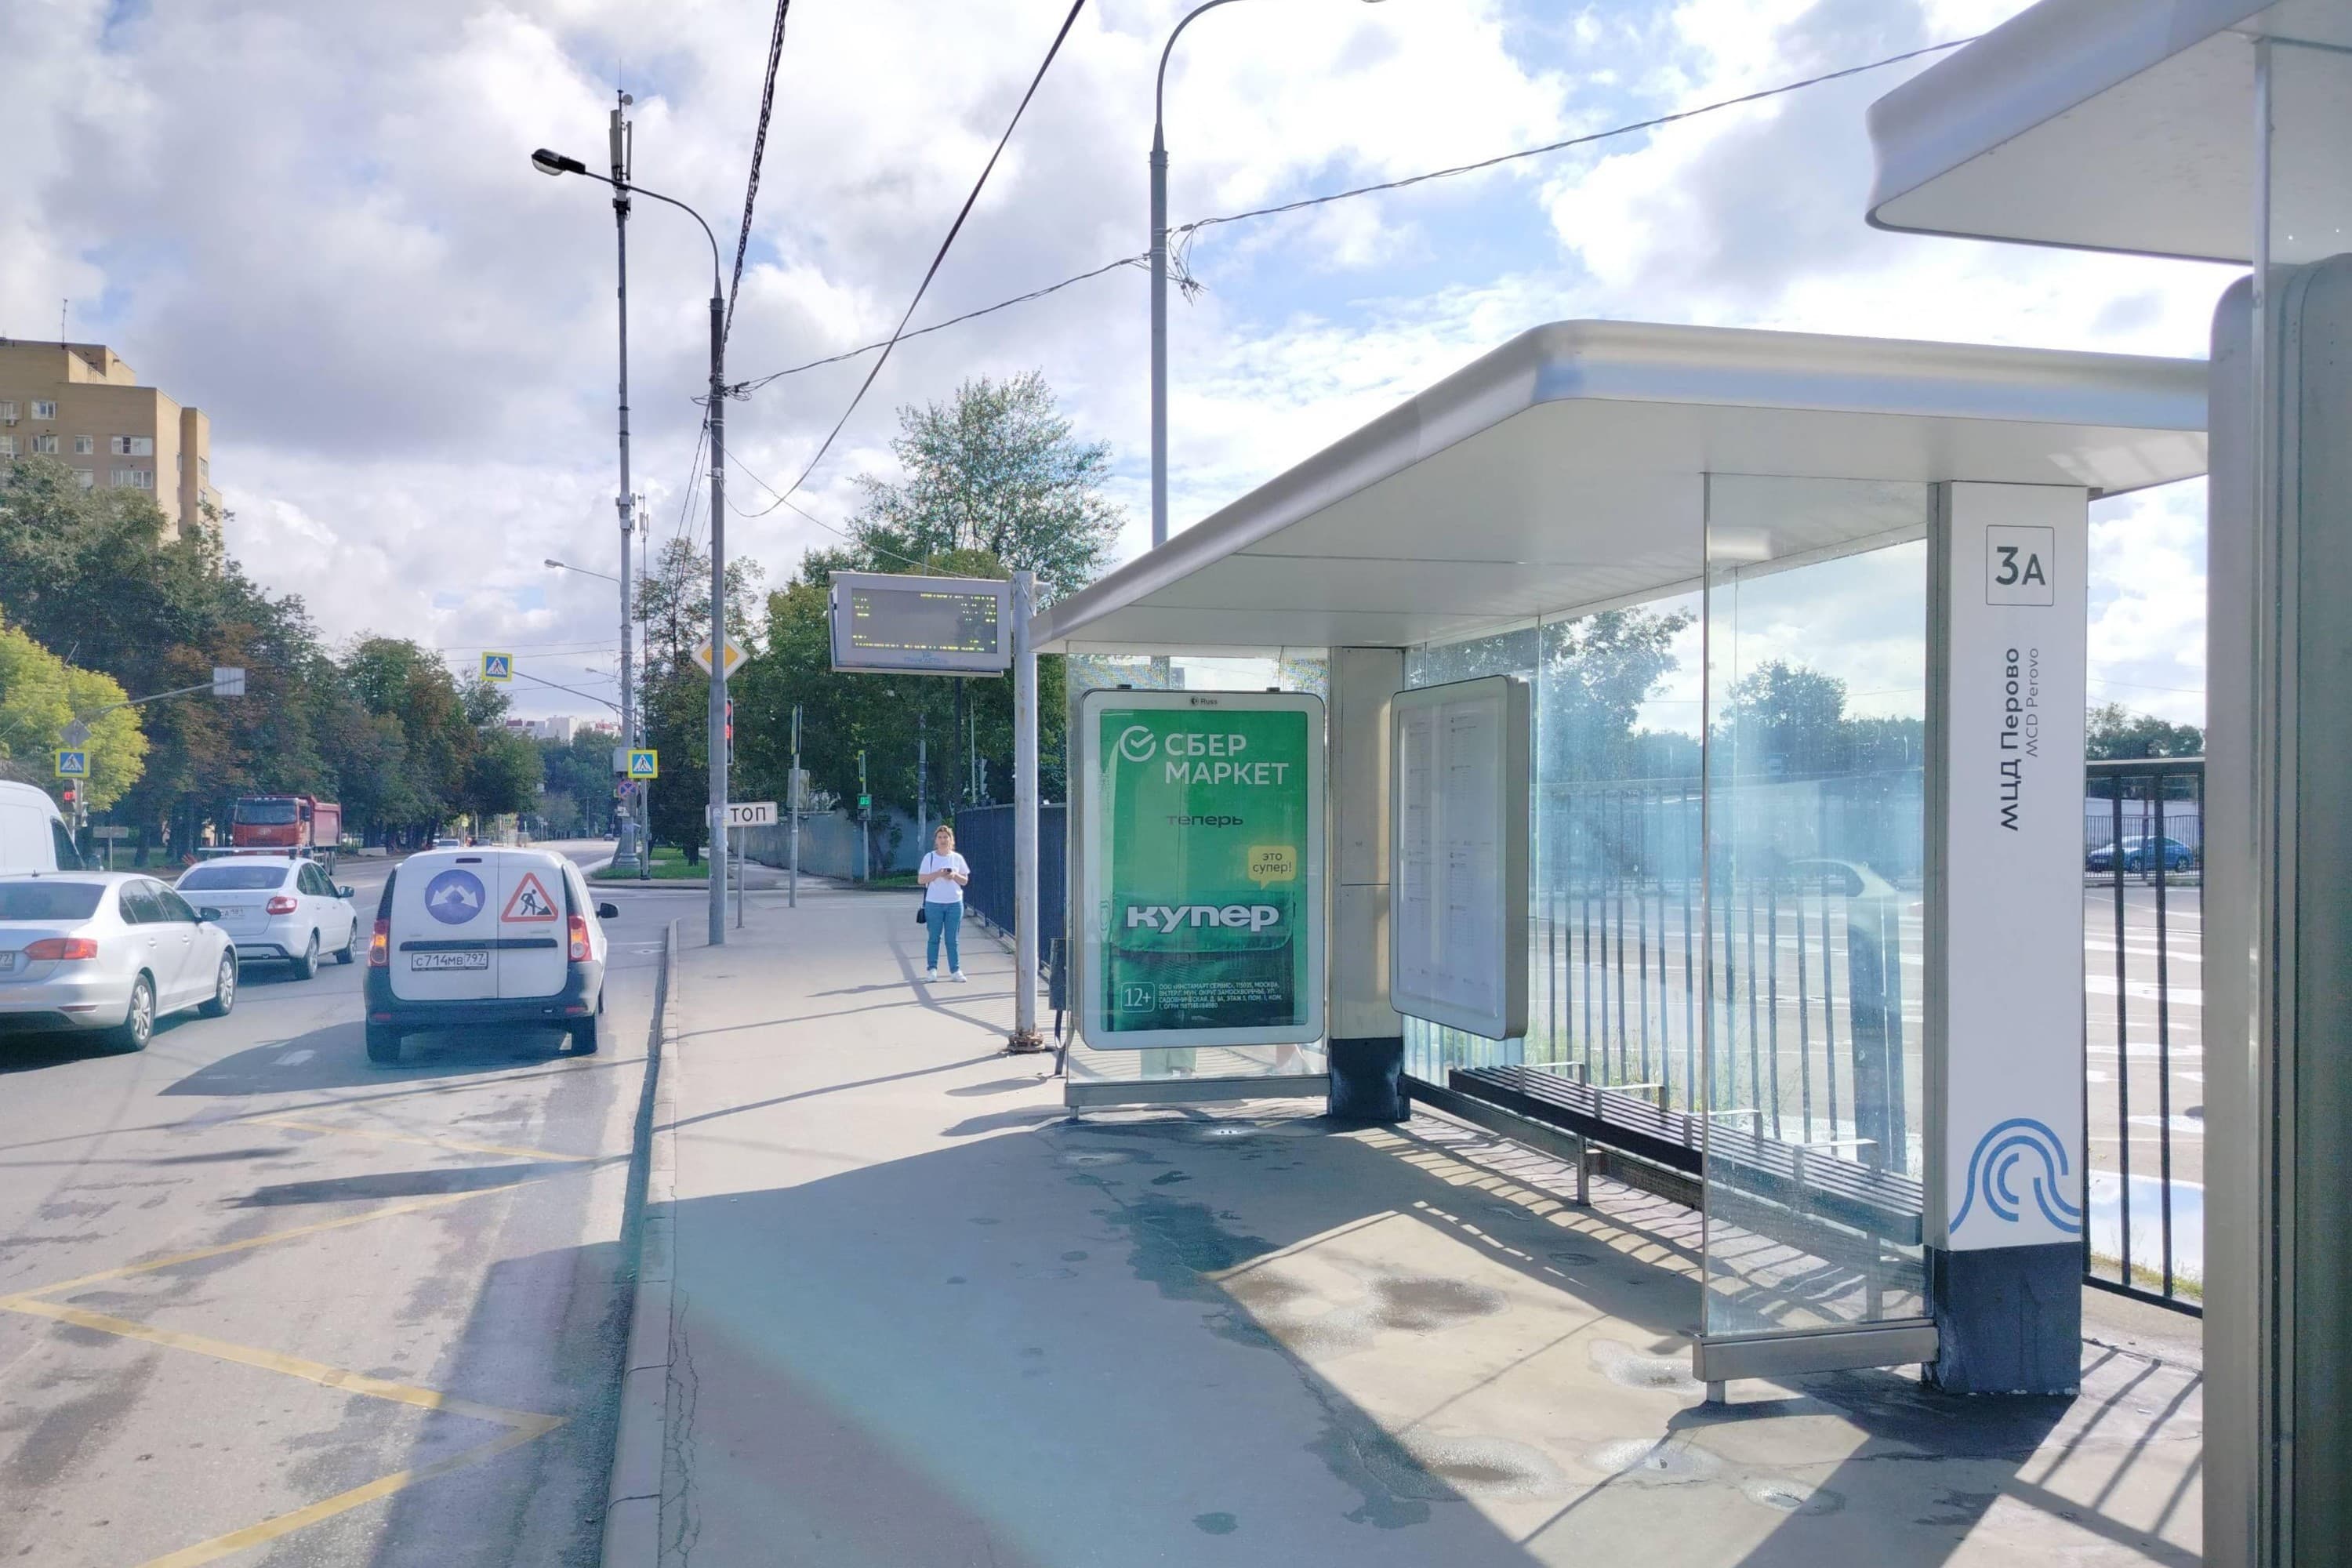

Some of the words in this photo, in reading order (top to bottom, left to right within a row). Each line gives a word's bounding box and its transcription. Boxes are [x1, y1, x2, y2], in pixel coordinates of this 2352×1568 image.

[2026, 648, 2038, 708] Perovo
[2001, 648, 2022, 750] Перово
[1165, 733, 1247, 757] СБЕР
[2026, 713, 2038, 757] MCD
[1166, 762, 1289, 784] МАРКЕТ
[2001, 759, 2022, 831] МЦД
[729, 807, 766, 822] ТОП
[1166, 815, 1243, 828] теперь
[1253, 862, 1292, 873] супер!
[1127, 905, 1280, 934] купер
[1124, 988, 1152, 1007] 12+
